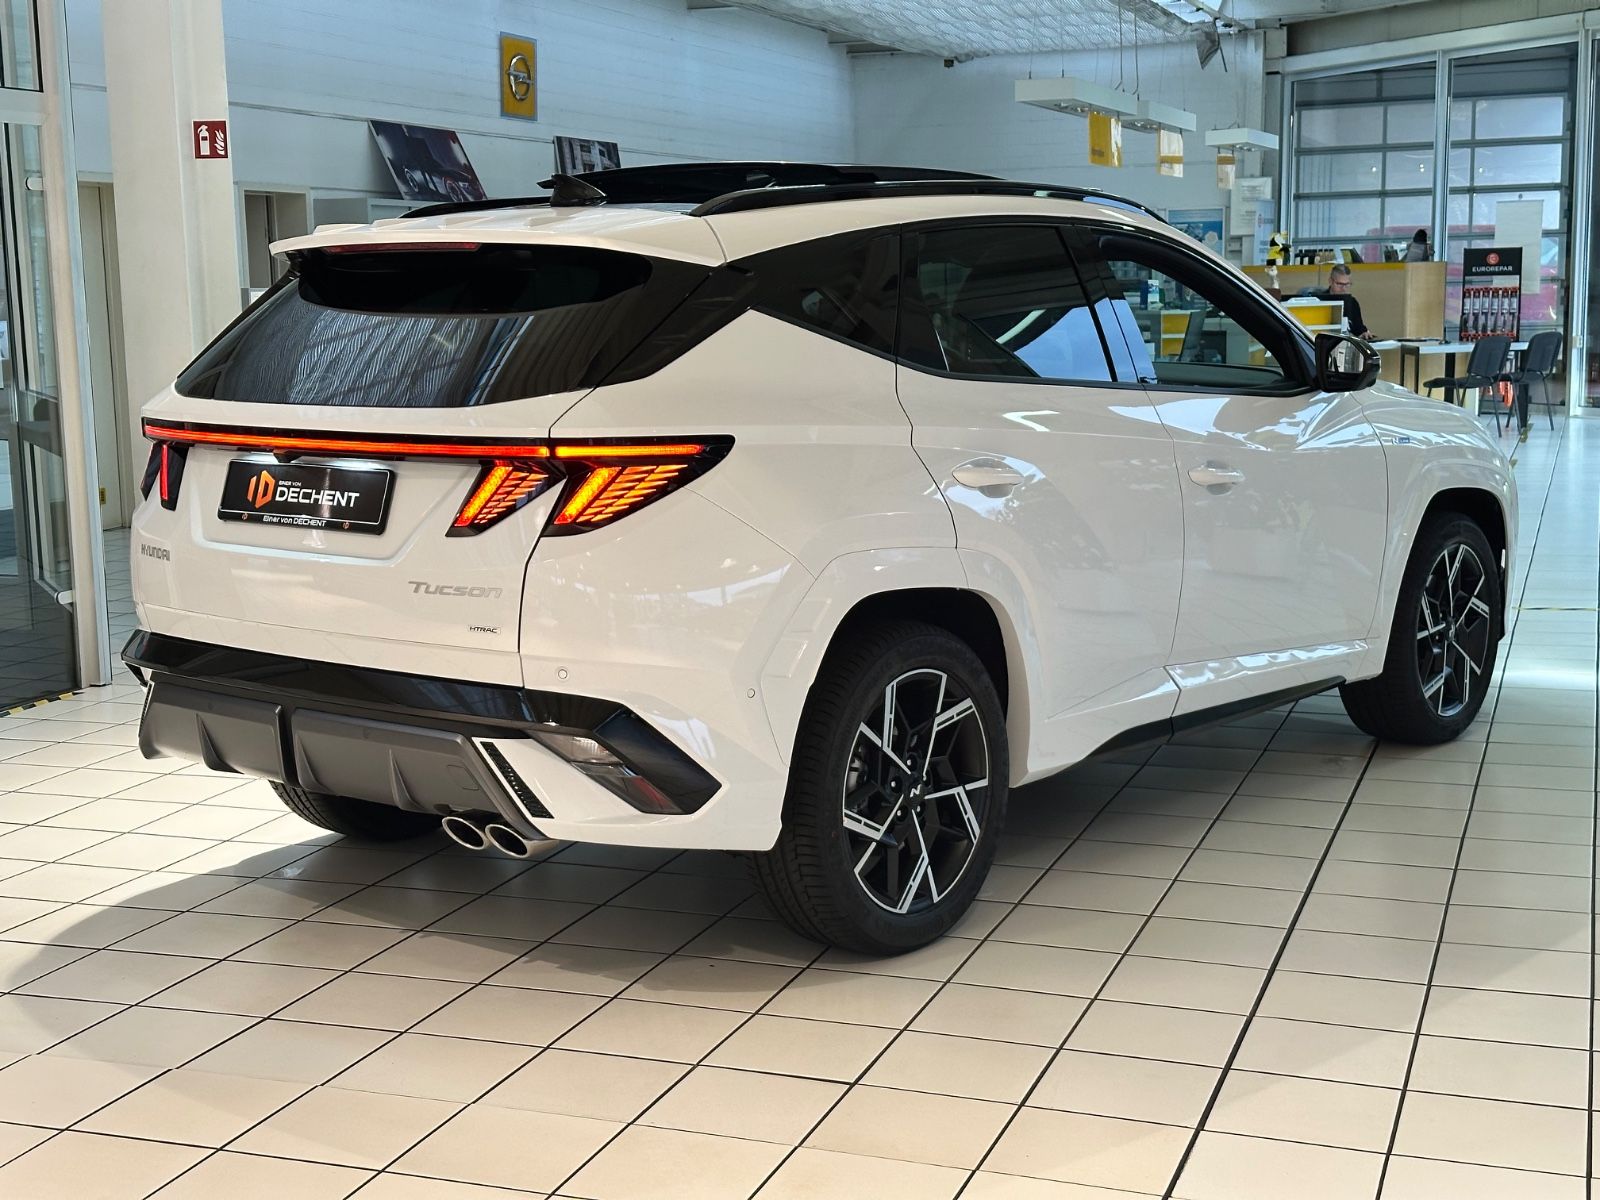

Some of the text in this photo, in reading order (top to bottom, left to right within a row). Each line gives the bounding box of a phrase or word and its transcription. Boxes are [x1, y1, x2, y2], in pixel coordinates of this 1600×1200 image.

[275, 486, 360, 508] DECHENT
[293, 517, 327, 527] DECHENT
[141, 543, 171, 561] HYUNDAI
[469, 626, 498, 634] HTRAC
